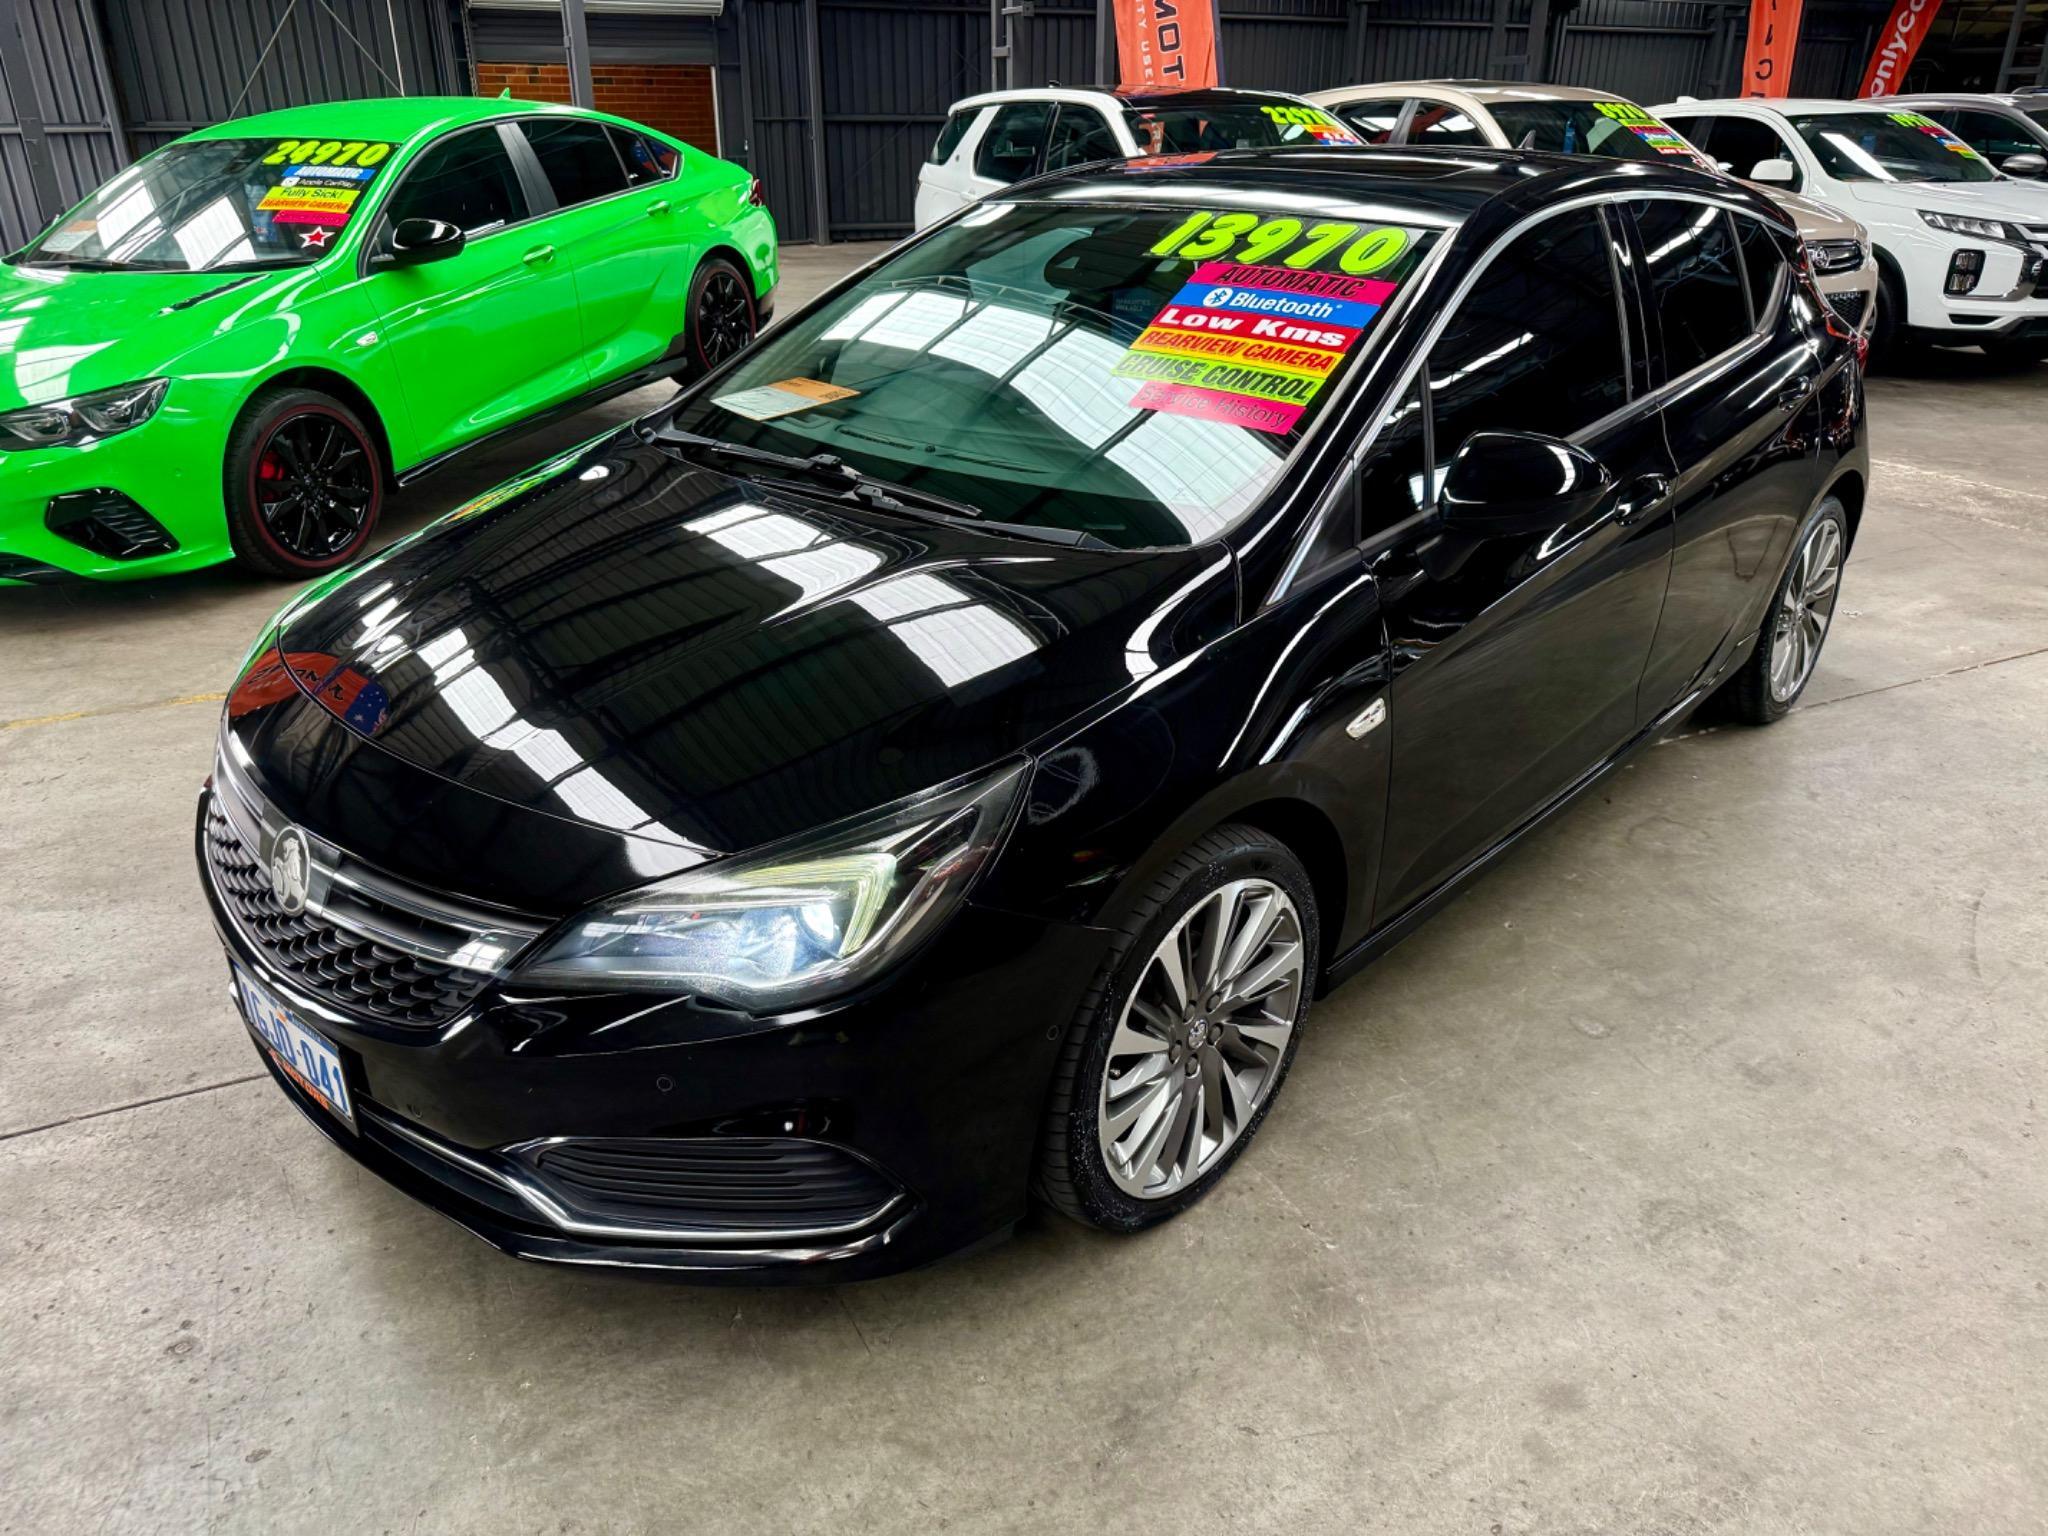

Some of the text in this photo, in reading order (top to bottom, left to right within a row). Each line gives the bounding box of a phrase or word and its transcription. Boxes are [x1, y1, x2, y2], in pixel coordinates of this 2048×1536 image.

[262, 140, 390, 167] 24970
[1150, 211, 1410, 275] 13970
[1215, 267, 1366, 298] AUTOMATIC
[1229, 291, 1335, 319] Bluetooth
[1158, 308, 1346, 347] Low Kms
[1139, 331, 1335, 372] REARVIEW CAMERA
[1118, 354, 1315, 401] CRUISE CONTROL
[1137, 384, 1292, 427] Service History
